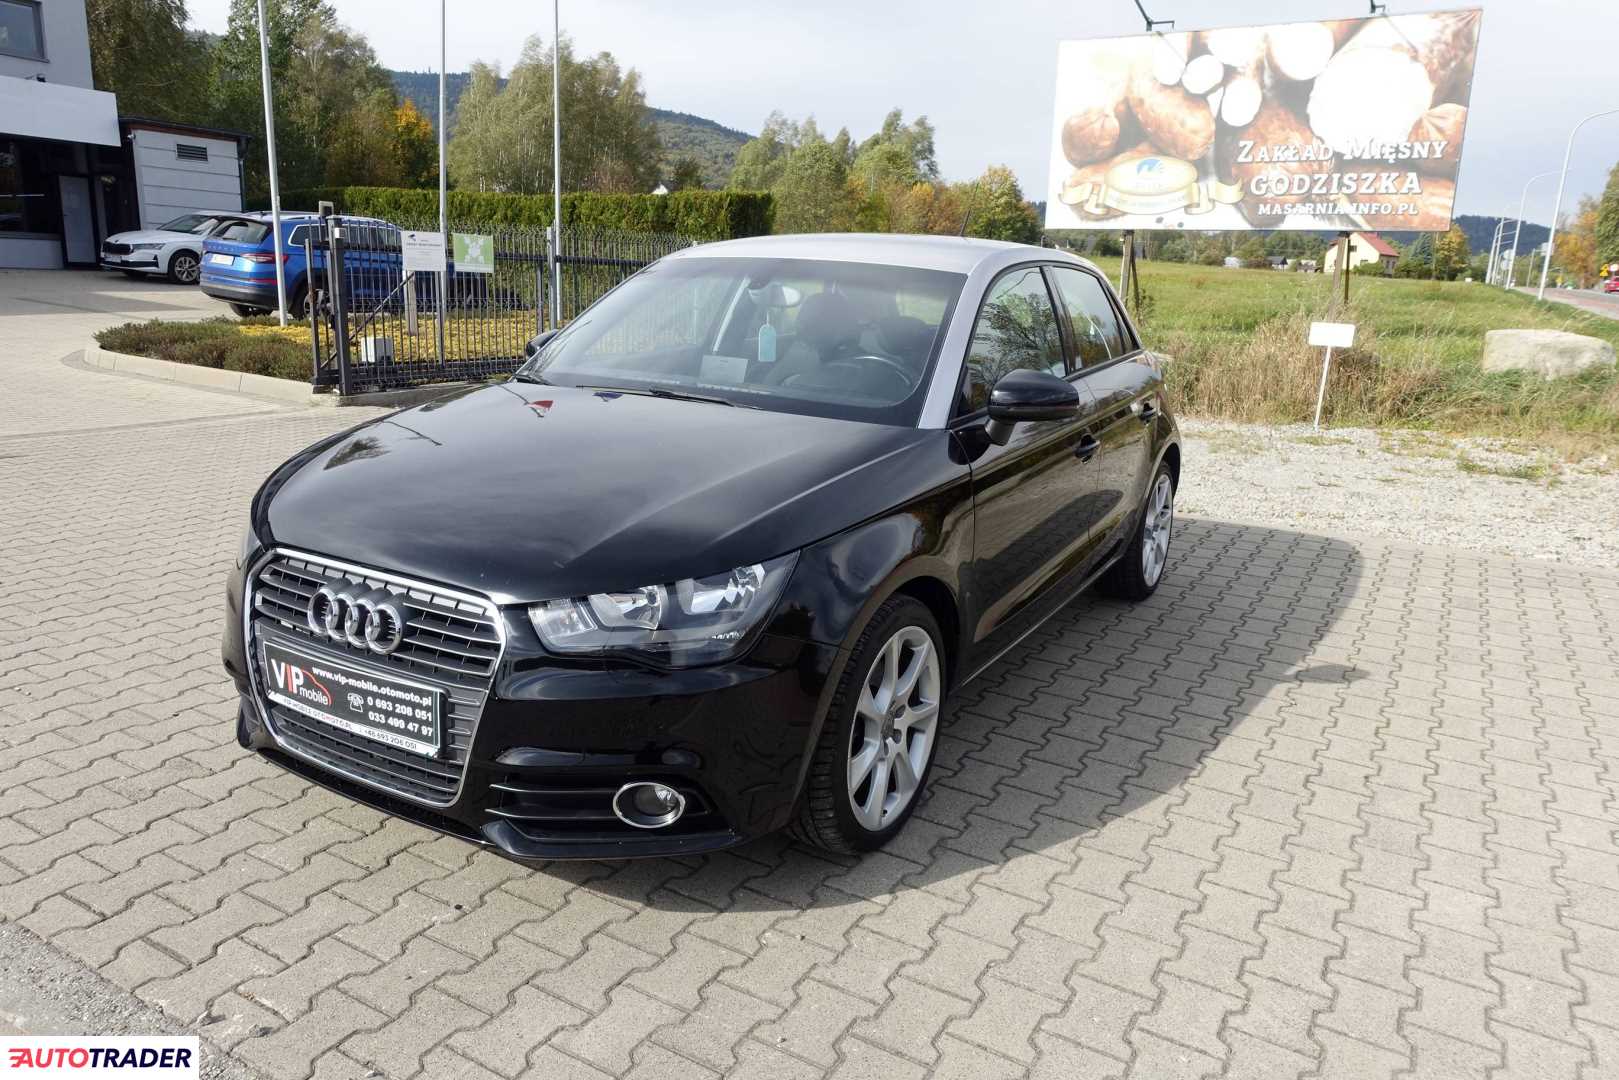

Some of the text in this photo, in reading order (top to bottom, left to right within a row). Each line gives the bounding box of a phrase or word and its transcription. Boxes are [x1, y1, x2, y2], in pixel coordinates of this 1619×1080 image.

[1237, 140, 1334, 163] ZAKŁAD
[1250, 172, 1422, 196] GODZISZKA
[271, 659, 304, 694] VIP
[299, 686, 329, 705] mobile
[367, 696, 374, 705] 0
[415, 708, 433, 722] 051
[368, 711, 386, 724] 033
[407, 721, 420, 733] 47
